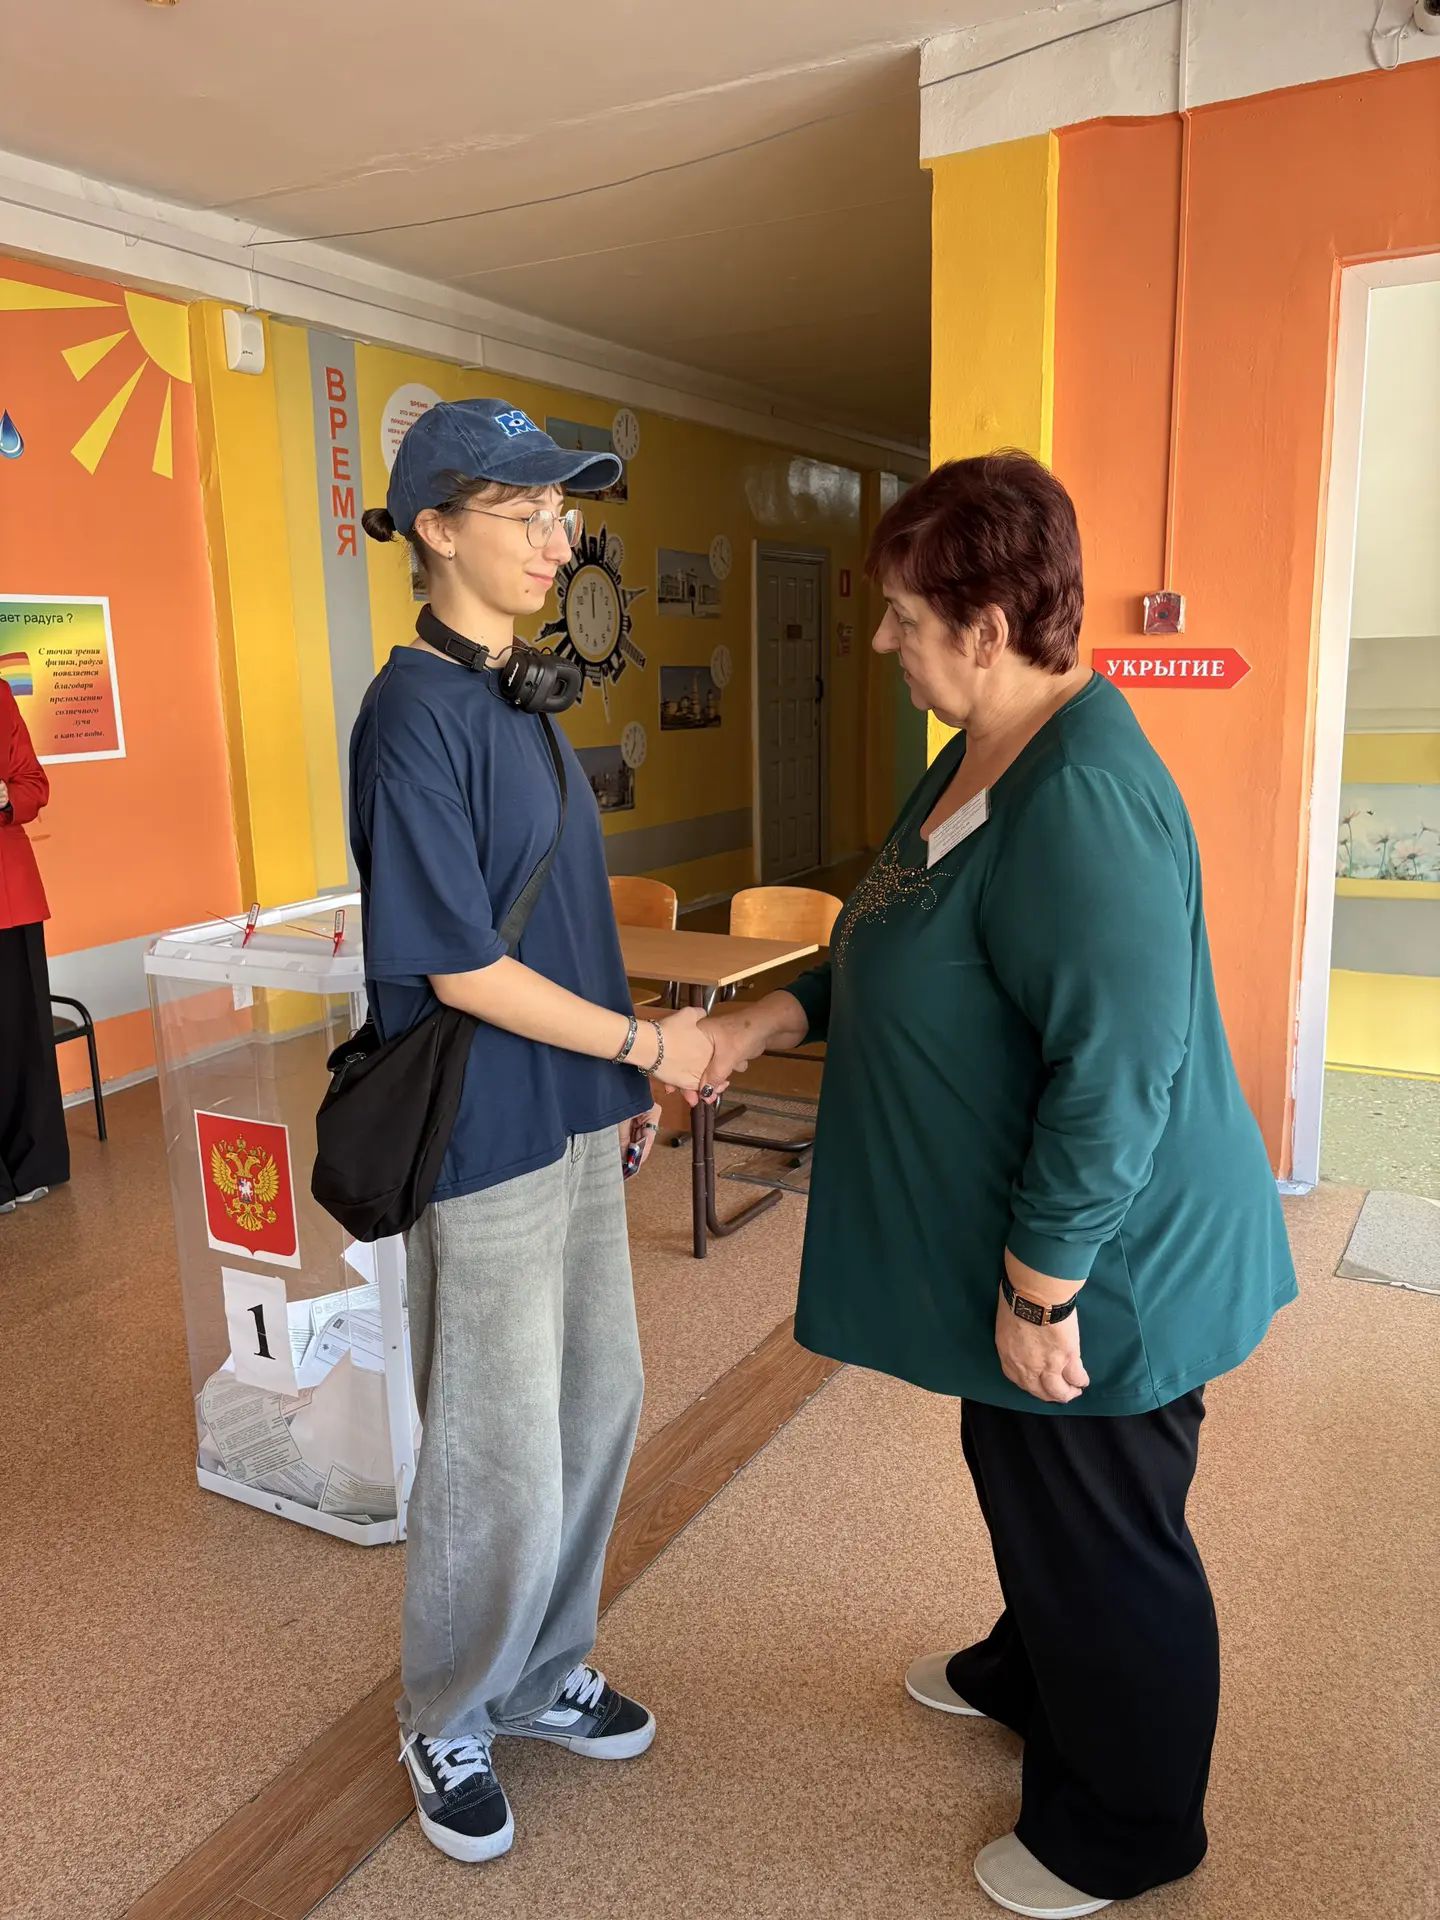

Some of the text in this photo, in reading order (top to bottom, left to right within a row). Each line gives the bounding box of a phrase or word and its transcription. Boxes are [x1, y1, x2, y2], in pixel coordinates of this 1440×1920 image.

[325, 366, 357, 557] ВРЕМЯ
[24, 614, 64, 625] радуга
[66, 612, 73, 623] ?
[75, 648, 101, 656] зрения
[78, 658, 103, 667] радуга
[1106, 659, 1225, 677] УКРЫТИЕ
[54, 682, 94, 690] благодаря
[49, 695, 103, 704] преломлению
[55, 708, 99, 716] солнечного
[247, 1303, 277, 1360] 1
